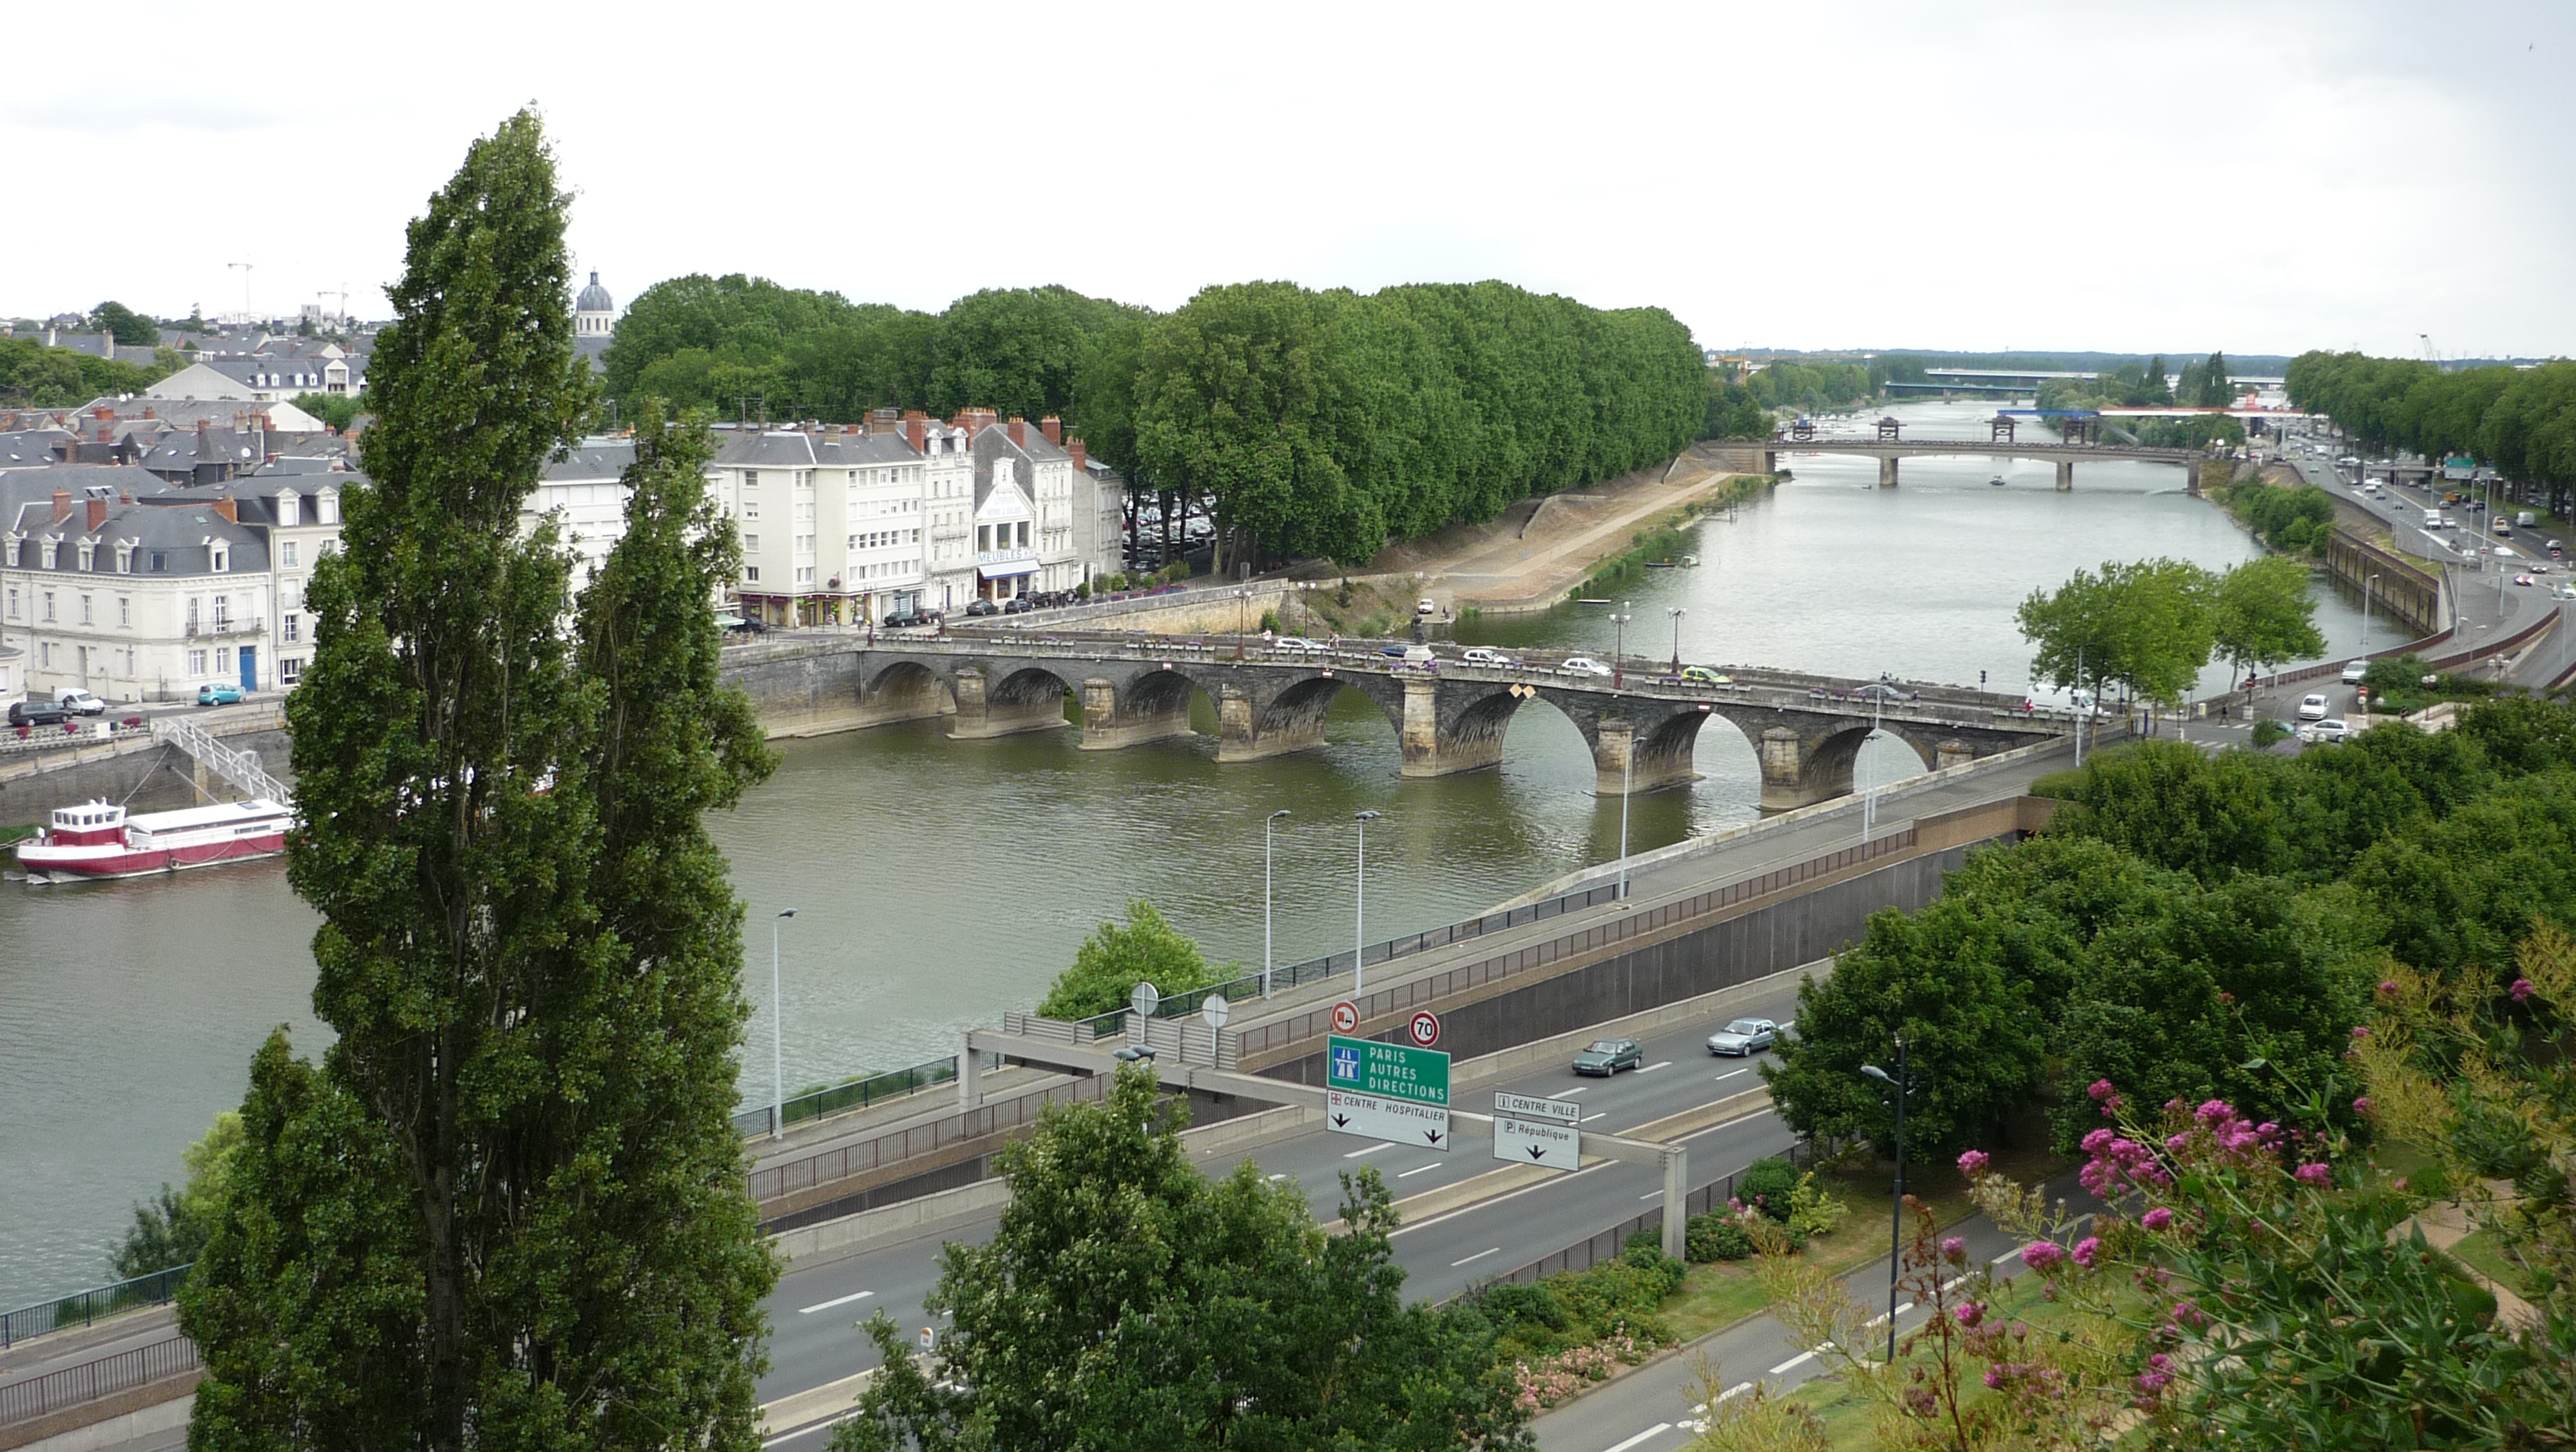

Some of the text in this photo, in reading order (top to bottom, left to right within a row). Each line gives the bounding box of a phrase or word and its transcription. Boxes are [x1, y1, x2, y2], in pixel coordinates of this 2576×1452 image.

[979, 549, 1022, 563] MEUBLES
[1417, 1022, 1433, 1036] 70
[1369, 1047, 1406, 1063] PARIS
[1369, 1062, 1417, 1080] AUTRES
[1368, 1077, 1444, 1100] DIRECTIONS
[1344, 1096, 1445, 1121] CENTRE HOSPITALIER
[1512, 1098, 1547, 1113] CENTRE
[1552, 1105, 1577, 1117] VILLE
[1506, 1122, 1570, 1141] P République
